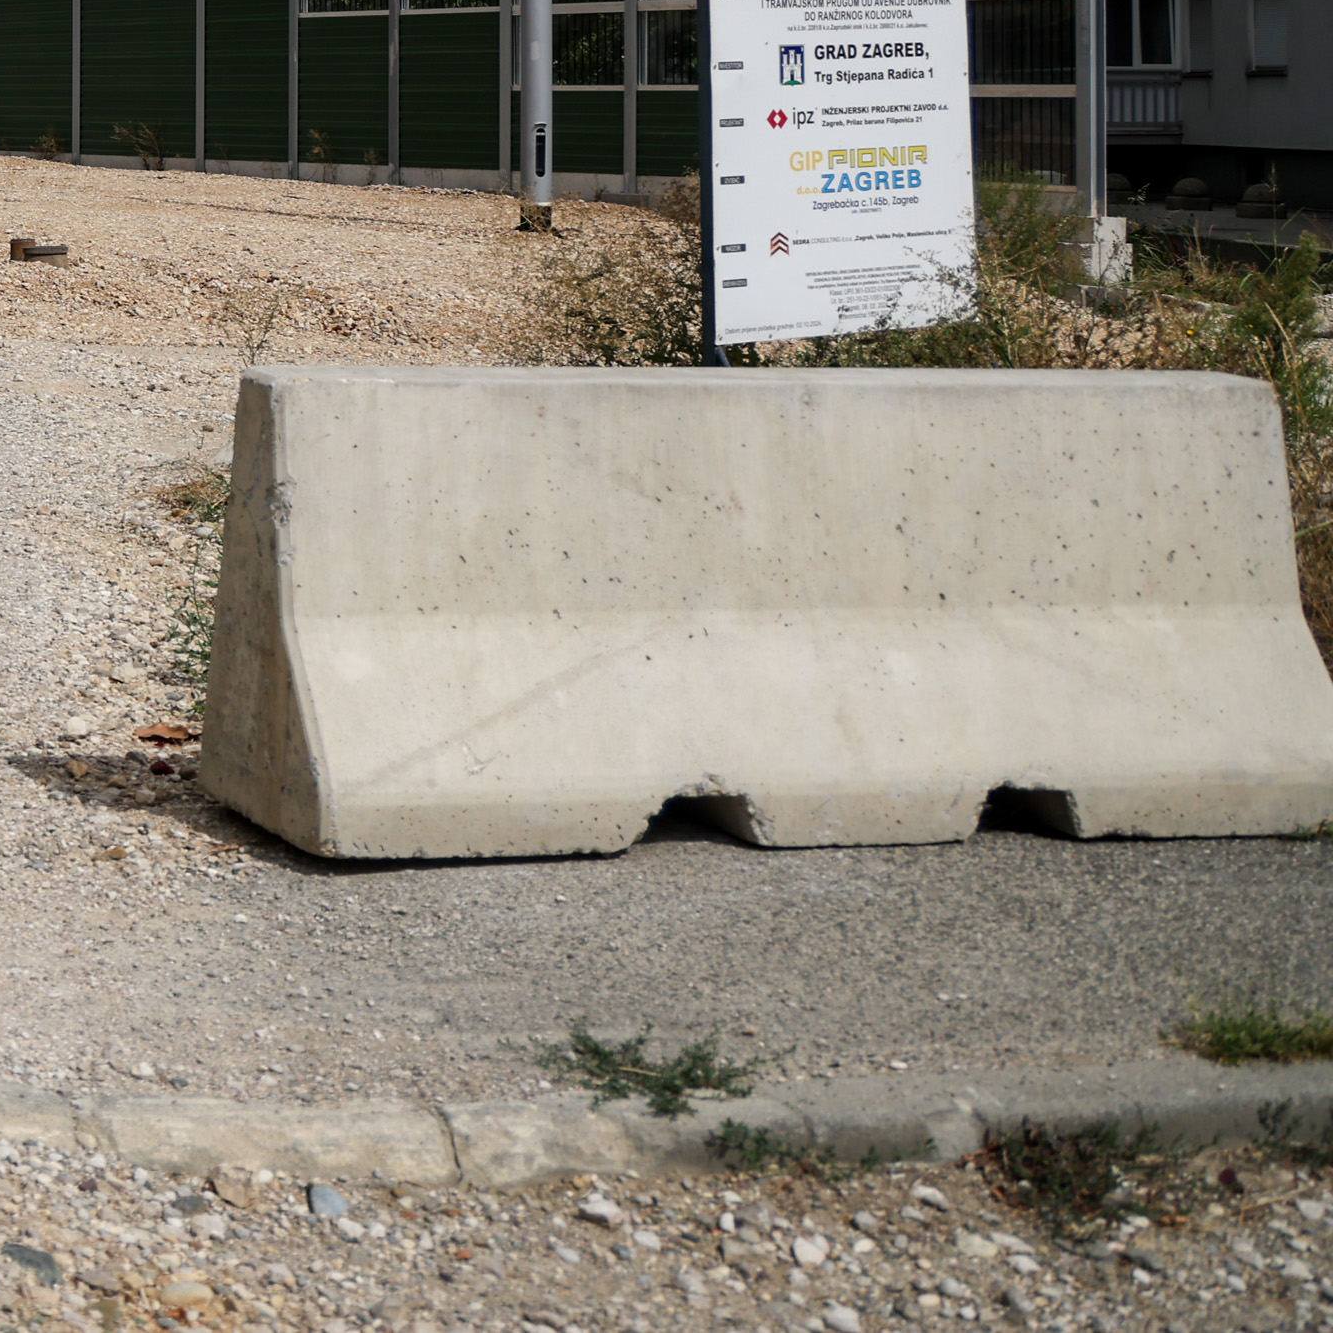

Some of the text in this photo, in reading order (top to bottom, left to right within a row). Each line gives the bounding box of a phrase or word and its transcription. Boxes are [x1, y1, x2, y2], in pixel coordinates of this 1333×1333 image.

[761, 0, 764, 9] I
[804, 9, 913, 22] DO RANŽIRNOG KOLODVORA
[815, 42, 929, 60] GRAD ZAGREB,
[815, 67, 934, 85] Trg Stjepana Radića 1
[822, 106, 870, 115] INŽENJERSKI
[871, 105, 912, 113] PROJEKTNI
[913, 103, 937, 112] ZAVOD
[792, 107, 815, 129] ipz
[822, 120, 845, 128] Zagreb,
[790, 145, 927, 172] GIP PIONIR
[797, 169, 922, 195] d.o.o. ZAGREB
[813, 199, 860, 211] Zagrebačka
[861, 197, 890, 208] c.145b,
[892, 195, 919, 207] Zagreb
[811, 236, 841, 244] CONSULTING
